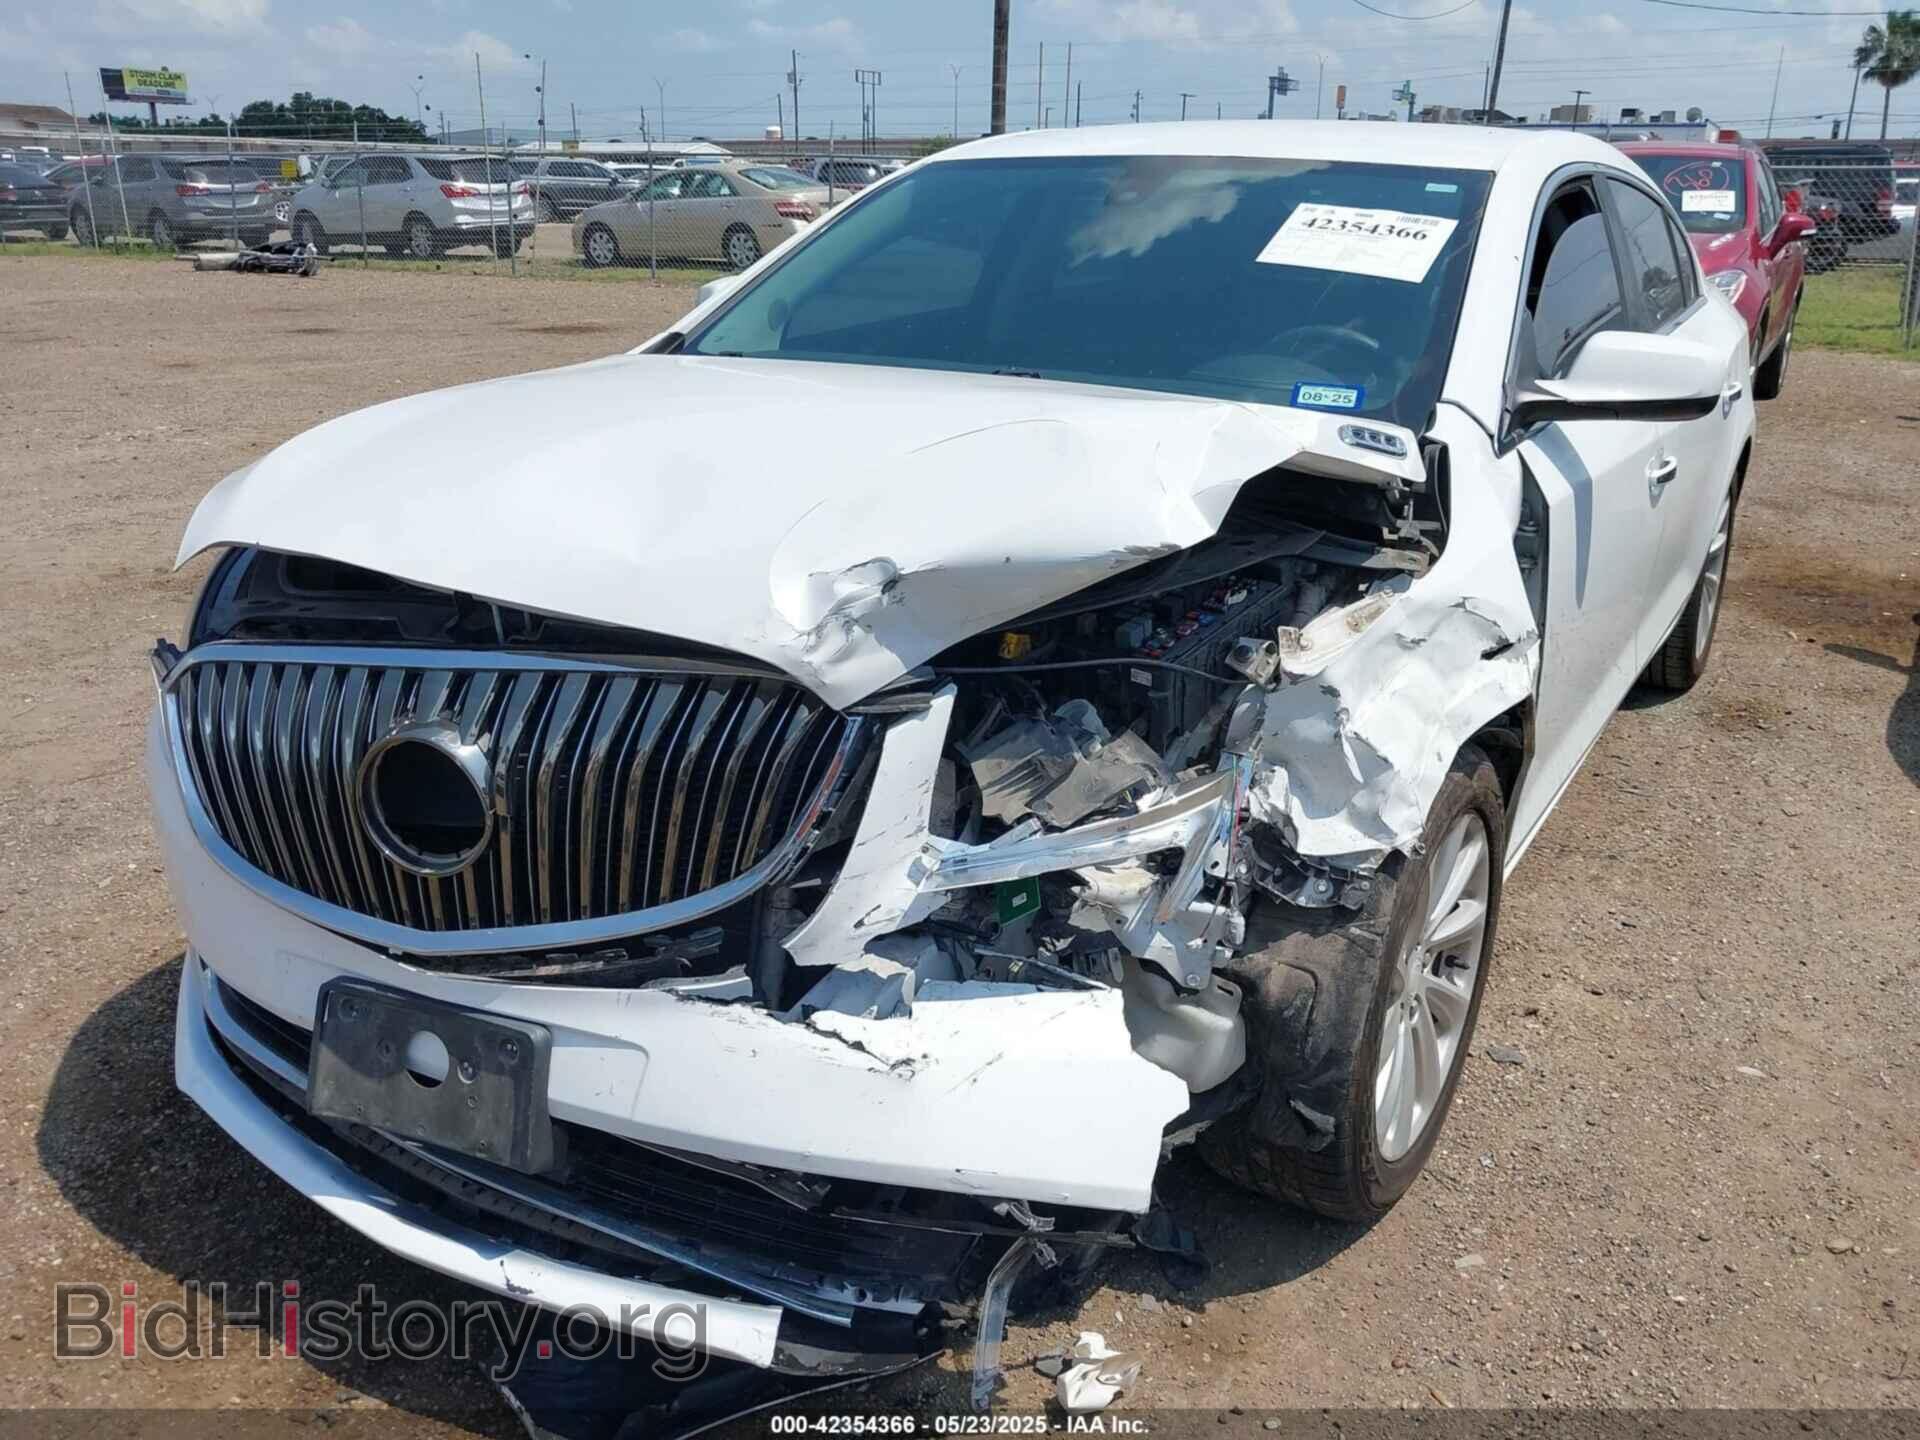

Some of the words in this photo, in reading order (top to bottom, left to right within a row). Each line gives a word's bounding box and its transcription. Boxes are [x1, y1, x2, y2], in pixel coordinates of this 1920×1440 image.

[128, 69, 156, 78] STORM
[158, 72, 183, 81] CLAIM
[136, 78, 176, 88] DEADLINE
[1301, 217, 1428, 241] 42354366
